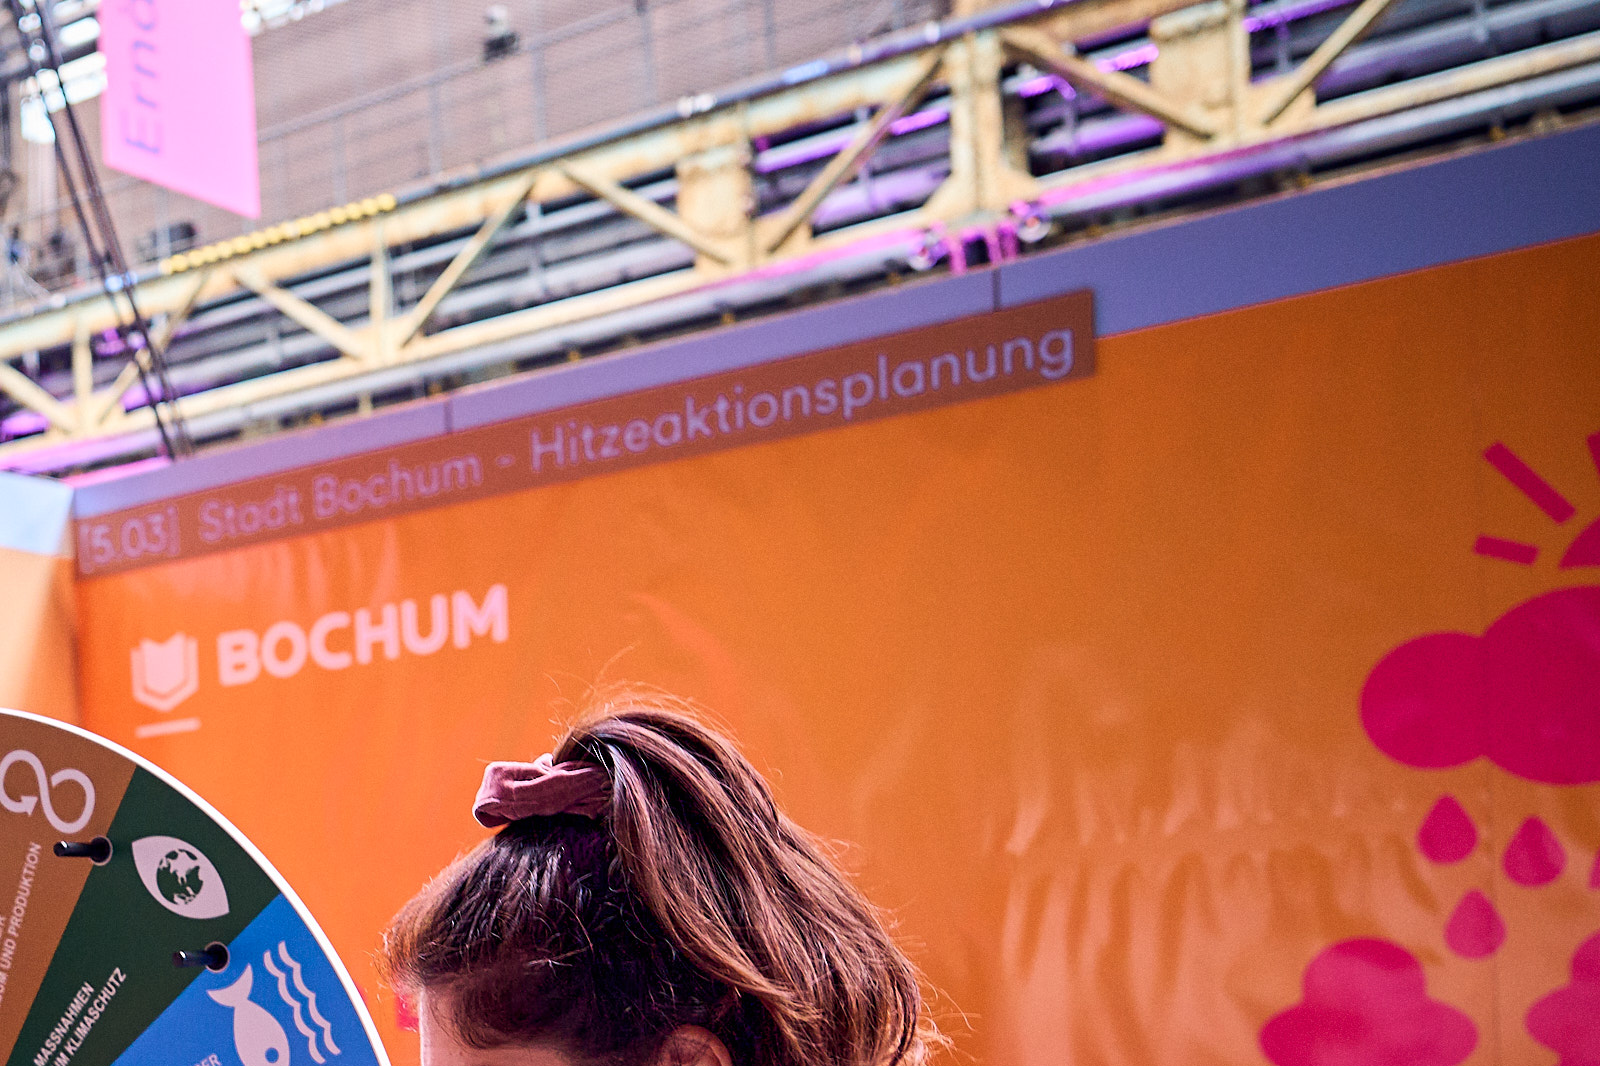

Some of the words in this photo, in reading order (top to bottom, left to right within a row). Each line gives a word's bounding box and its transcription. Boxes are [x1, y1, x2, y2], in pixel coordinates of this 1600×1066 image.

[199, 485, 303, 542] Stadt
[312, 451, 483, 522] Bochum
[531, 325, 1074, 475] Hitzeaktionsplanung
[217, 585, 509, 687] BOCHUM
[7, 842, 42, 938] PRODUKTION
[0, 938, 17, 970] UND
[64, 967, 127, 1058] KLIMASCHUTZ
